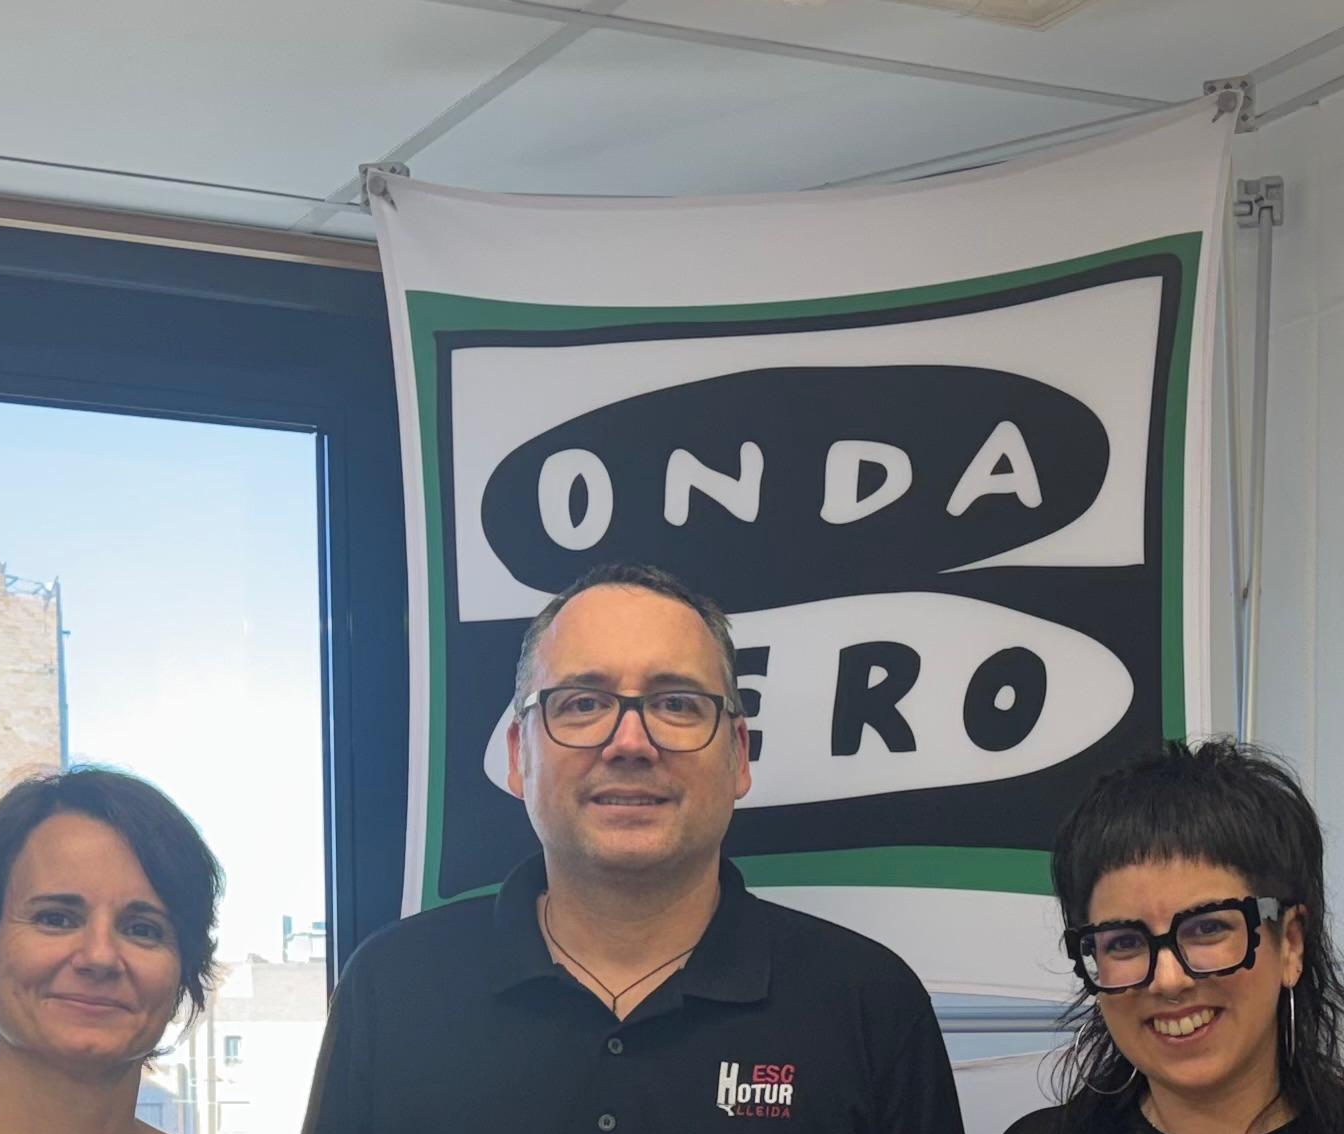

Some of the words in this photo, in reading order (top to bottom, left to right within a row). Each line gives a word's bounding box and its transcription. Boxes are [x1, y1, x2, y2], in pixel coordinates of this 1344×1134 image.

[537, 421, 1043, 552] ONDA
[735, 640, 1047, 762] ERO
[752, 1064, 795, 1083] ESC
[737, 1106, 790, 1118] LLEIDA
